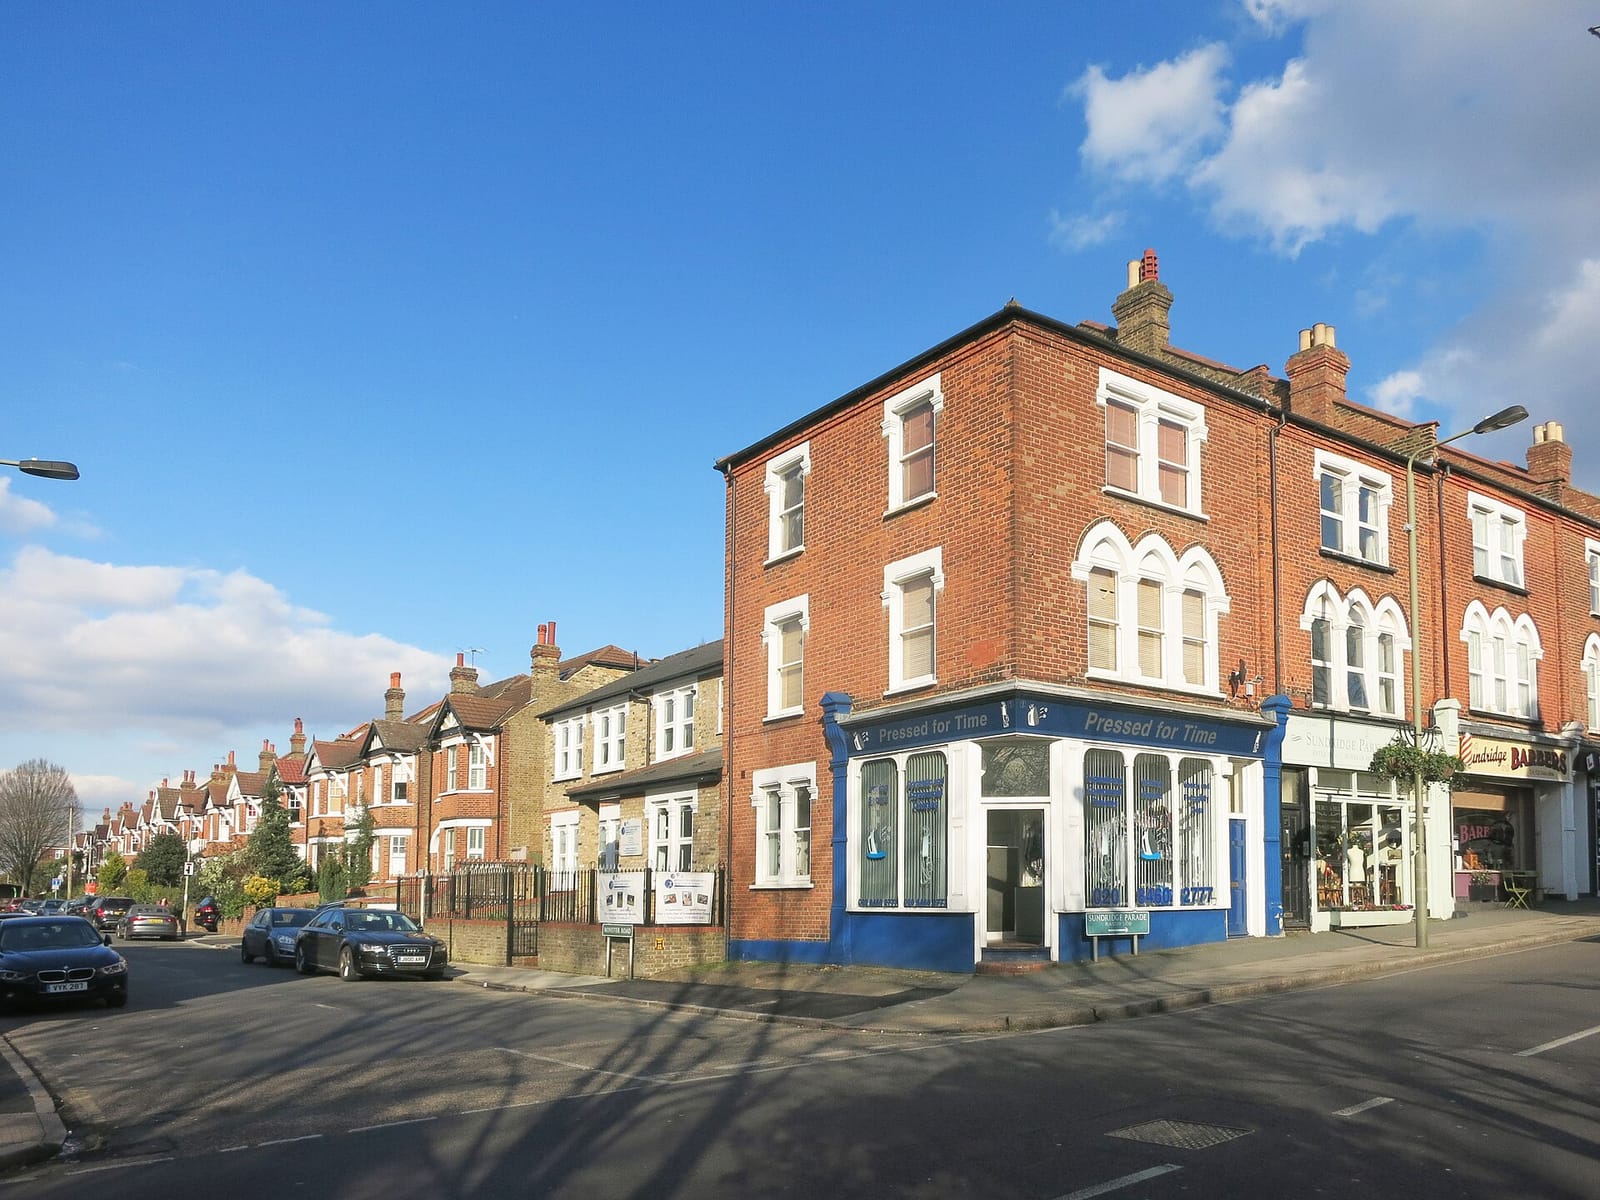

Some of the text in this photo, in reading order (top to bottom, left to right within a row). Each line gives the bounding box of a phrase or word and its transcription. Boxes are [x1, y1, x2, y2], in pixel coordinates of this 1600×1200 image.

[879, 713, 988, 743] Pressed for Time
[1084, 711, 1217, 745] Pressed for Time
[1467, 746, 1507, 767] undridge
[1180, 886, 1213, 904] 2777
[1088, 913, 1147, 922] SUNDRIDGE PARADE
